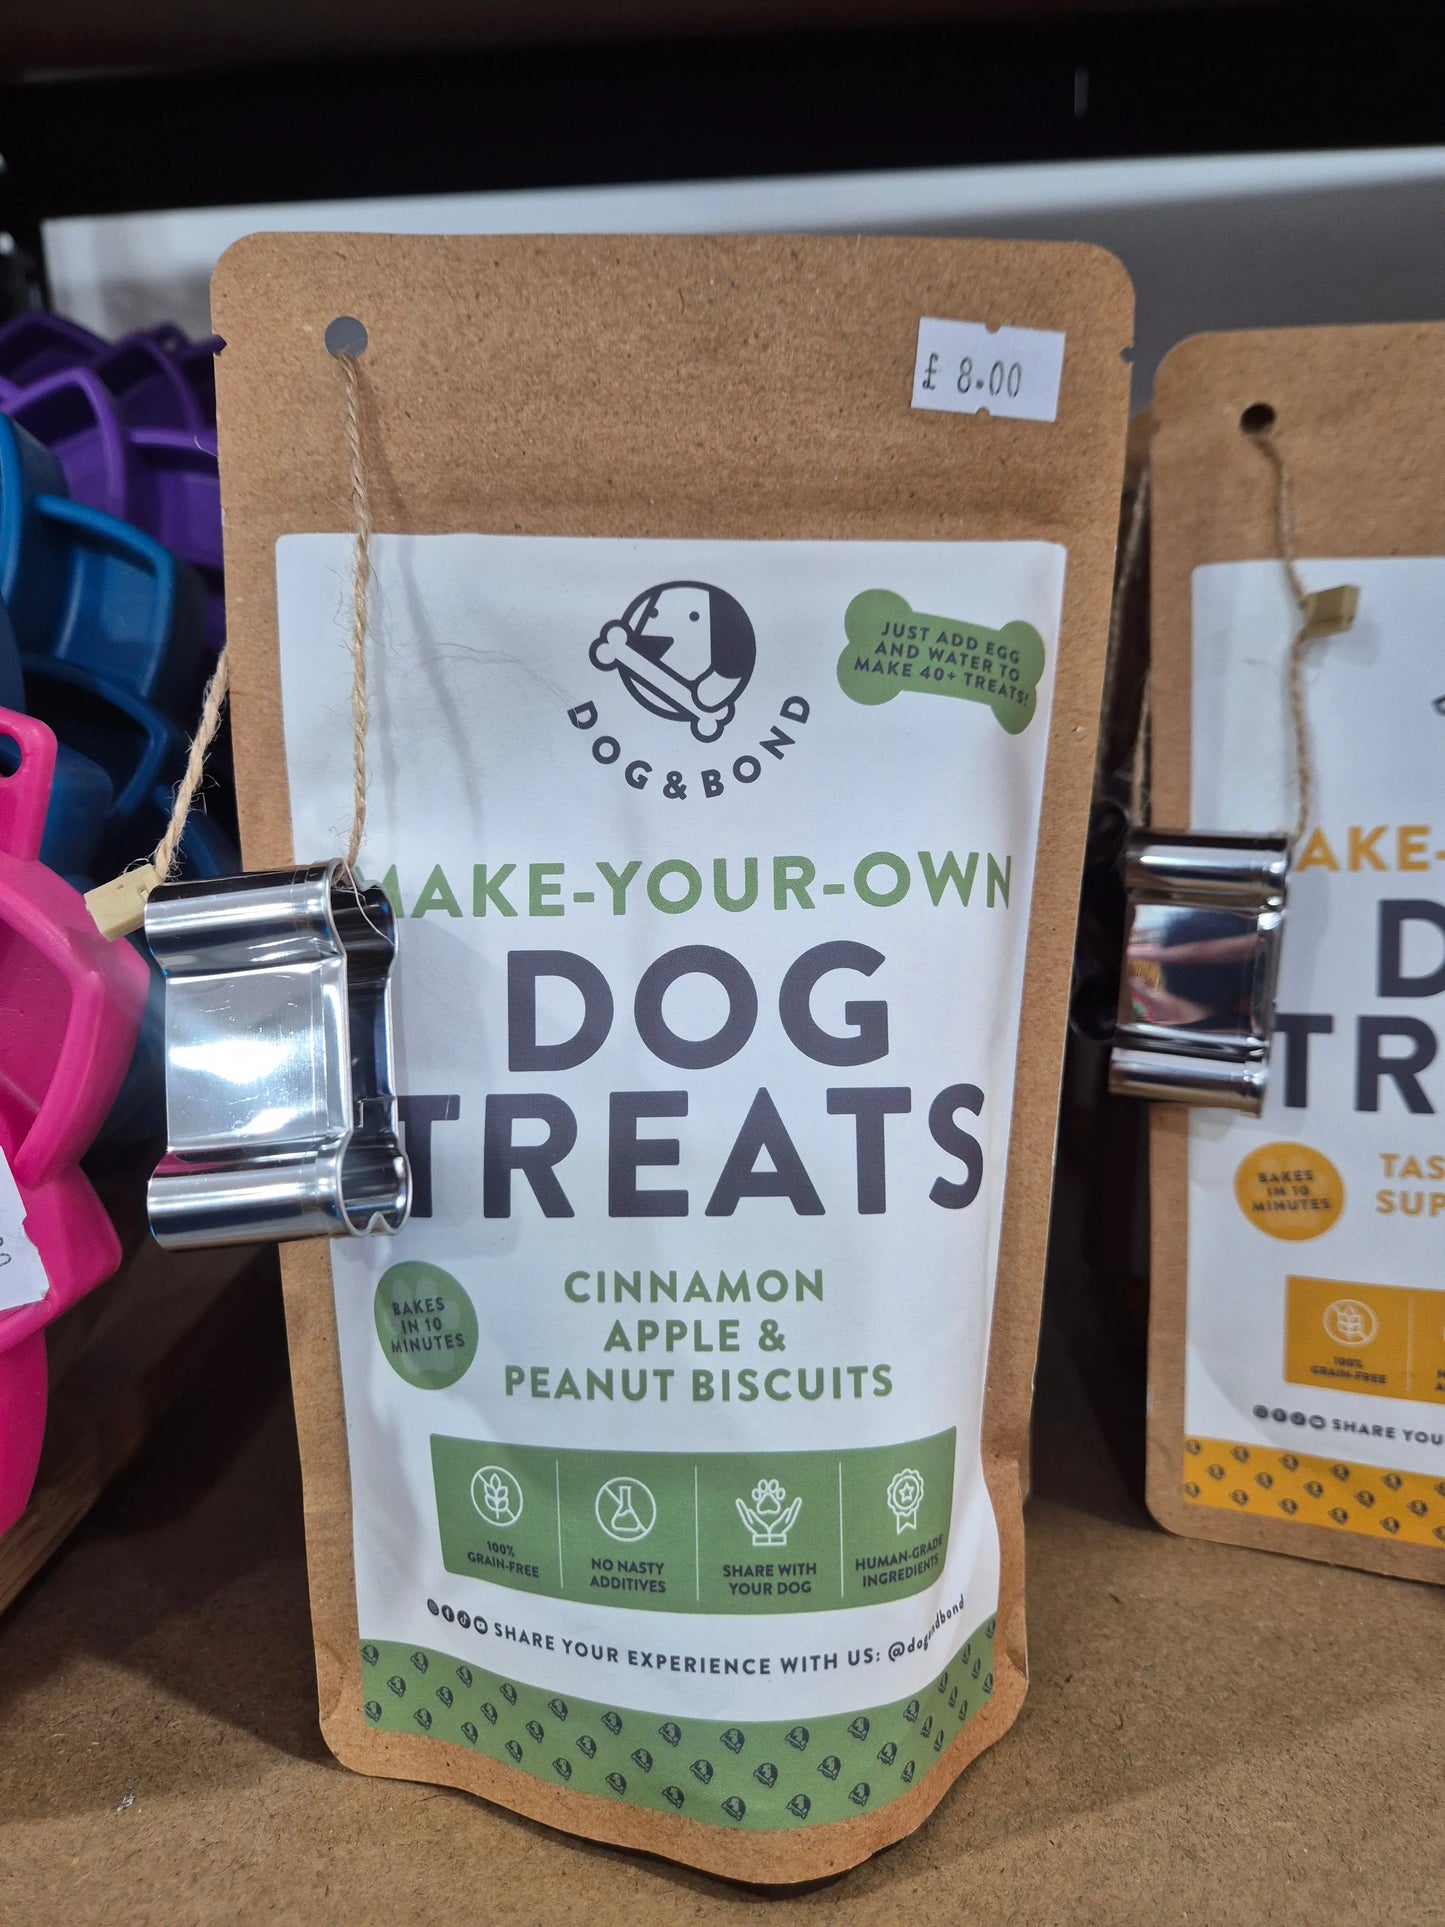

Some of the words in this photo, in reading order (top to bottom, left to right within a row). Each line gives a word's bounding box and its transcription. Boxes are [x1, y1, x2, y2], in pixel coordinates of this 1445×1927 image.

[881, 621, 930, 642] JUST
[935, 630, 978, 650] ADD
[986, 641, 1020, 664] EGG
[874, 641, 920, 659] AND
[929, 647, 993, 674] WATER
[1000, 664, 1020, 682] TO
[854, 655, 913, 677] MAKE
[919, 667, 956, 681] 40+
[964, 672, 1029, 706] TREATS!
[507, 940, 890, 1072] DOG
[397, 1083, 985, 1219] TREATS
[1257, 1169, 1315, 1183] BAKES
[1252, 1197, 1331, 1212] MINUTES
[564, 1268, 824, 1303] CINNAMON
[392, 1296, 445, 1316] BAKES
[401, 1318, 419, 1334] IN
[424, 1316, 442, 1332] 10
[603, 1318, 741, 1353] APPLE
[758, 1318, 787, 1352] &
[391, 1333, 465, 1353] MINUTES
[505, 1364, 676, 1401] PEANUT
[692, 1363, 894, 1402] BISCUITS
[1331, 1418, 1396, 1439] SHARE
[486, 1540, 515, 1558] 100%
[855, 1533, 944, 1571] HUMAN-GRADE
[467, 1551, 540, 1578] GRAIN-FREE
[591, 1557, 614, 1572] NO
[618, 1560, 664, 1575] NASTY
[723, 1563, 774, 1577] SHARE
[777, 1562, 817, 1576] WITH
[862, 1552, 939, 1588] INGREDIENTS
[590, 1575, 666, 1593] ADDITIVES
[729, 1582, 773, 1596] YOUR
[777, 1581, 811, 1595] DOG
[494, 1622, 555, 1650] SHARE
[561, 1638, 618, 1663] YOUR
[628, 1650, 771, 1675] EXPERIENCE
[780, 1652, 838, 1674] WITH
[847, 1647, 881, 1666] US:
